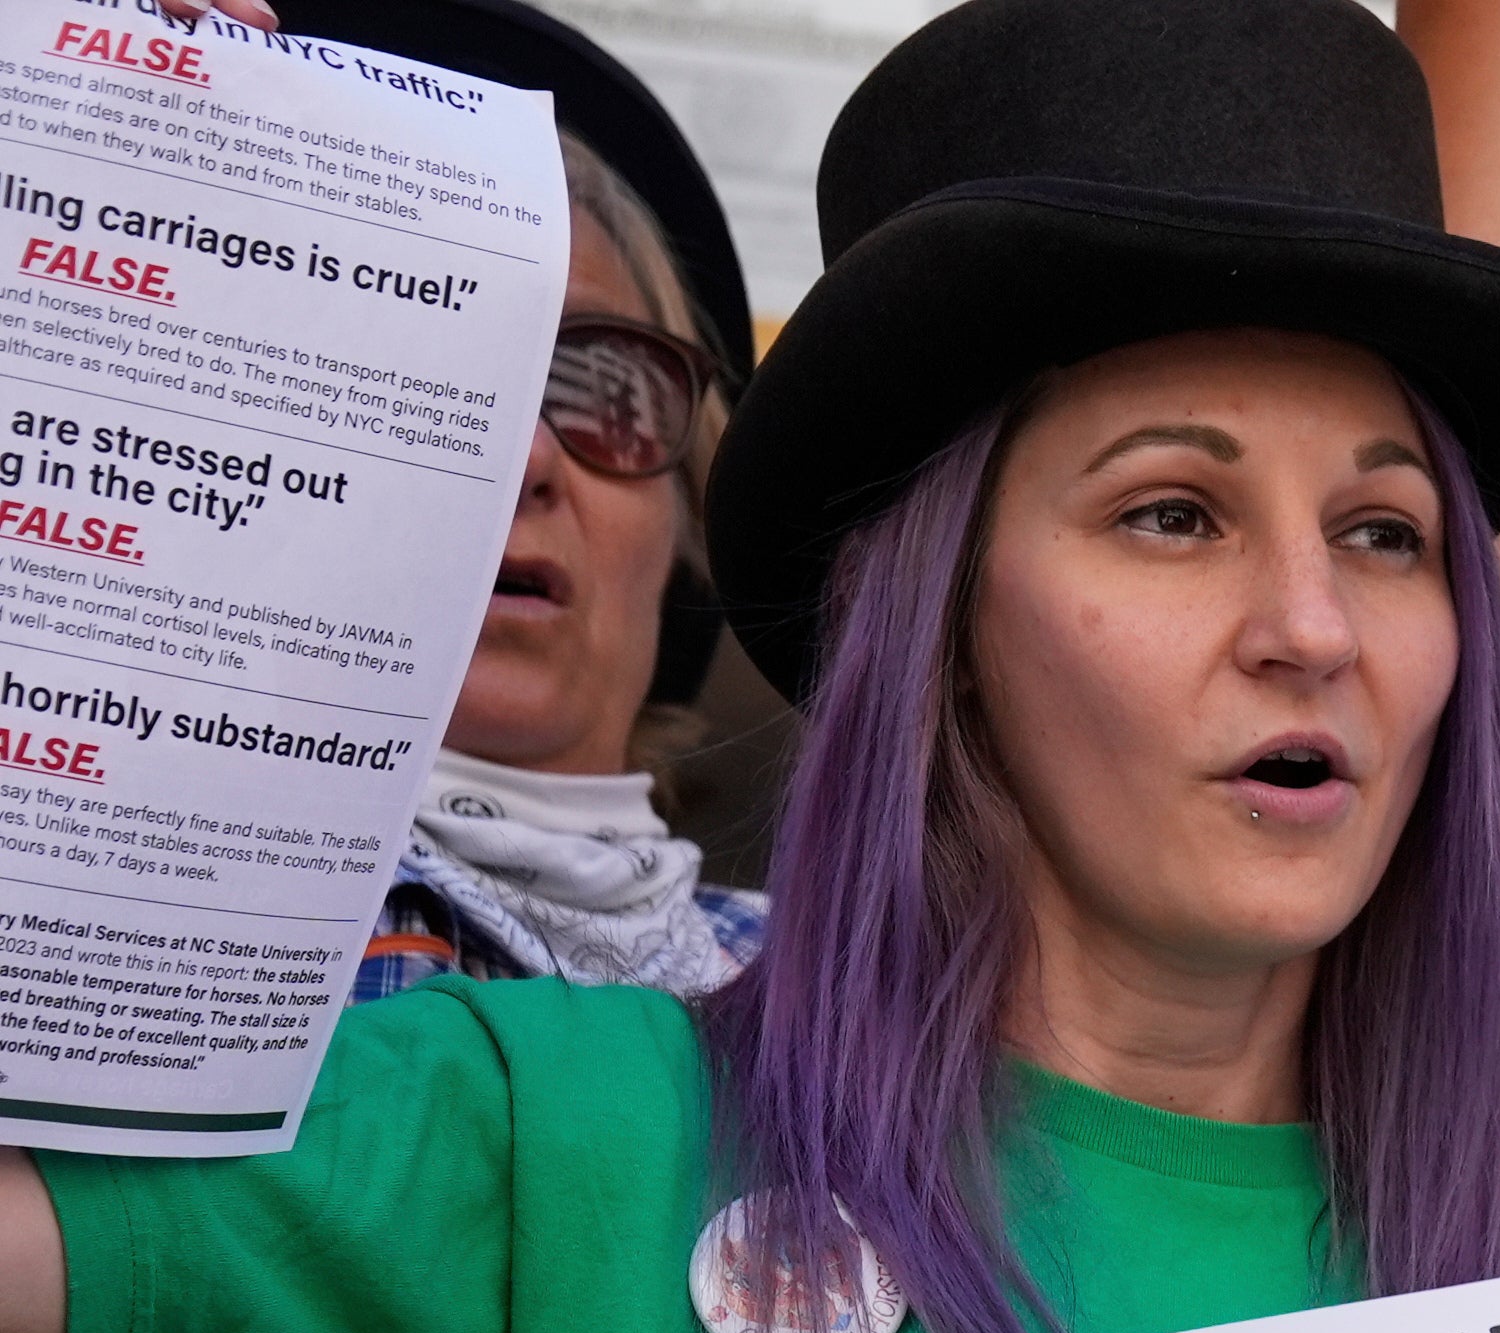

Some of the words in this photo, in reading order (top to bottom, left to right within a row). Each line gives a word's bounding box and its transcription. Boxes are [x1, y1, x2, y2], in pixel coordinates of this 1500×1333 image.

[53, 21, 211, 83] FALSE.
[207, 15, 250, 43] in
[262, 31, 345, 71] NYC
[22, 65, 82, 89] spend
[88, 77, 154, 104] almost
[159, 92, 181, 110] all
[186, 99, 206, 115] of
[209, 104, 251, 127] their
[255, 115, 294, 139] time
[299, 130, 365, 156] outside
[370, 144, 411, 167] their
[415, 159, 476, 185] stables
[482, 172, 496, 190] in
[76, 102, 124, 123] rides
[129, 114, 160, 132] are
[165, 123, 188, 139] on
[194, 127, 229, 151] city
[233, 138, 297, 166] streets.
[304, 153, 337, 175] The
[342, 163, 381, 186] time
[387, 174, 425, 200] they
[430, 188, 482, 211] spend
[488, 202, 509, 217] on
[515, 206, 542, 226] the
[19, 237, 178, 301] FALSE.
[98, 205, 295, 271] carriages
[308, 243, 340, 282] is
[80, 357, 101, 372] as
[107, 363, 186, 390] required
[190, 381, 226, 399] and
[230, 390, 313, 418] specified
[317, 404, 340, 428] by
[344, 411, 384, 434] NYC
[388, 425, 484, 457] regulations.
[11, 410, 80, 446] are
[92, 426, 272, 487] stressed
[283, 468, 348, 504] out
[37, 449, 74, 490] in
[89, 464, 155, 506] the
[0, 500, 145, 560] FALSE.
[10, 555, 87, 586] Western
[93, 572, 185, 609] University
[189, 596, 224, 613] and
[227, 604, 312, 631] published
[316, 617, 337, 639] by
[338, 623, 394, 647] JAVMA
[398, 633, 413, 650] in
[1, 671, 163, 741] horribly
[21, 914, 92, 938] Medical
[94, 925, 167, 948] Services
[170, 936, 187, 951] at
[190, 937, 216, 953] NC
[218, 940, 258, 958] State
[261, 944, 331, 965] University
[331, 947, 343, 961] in
